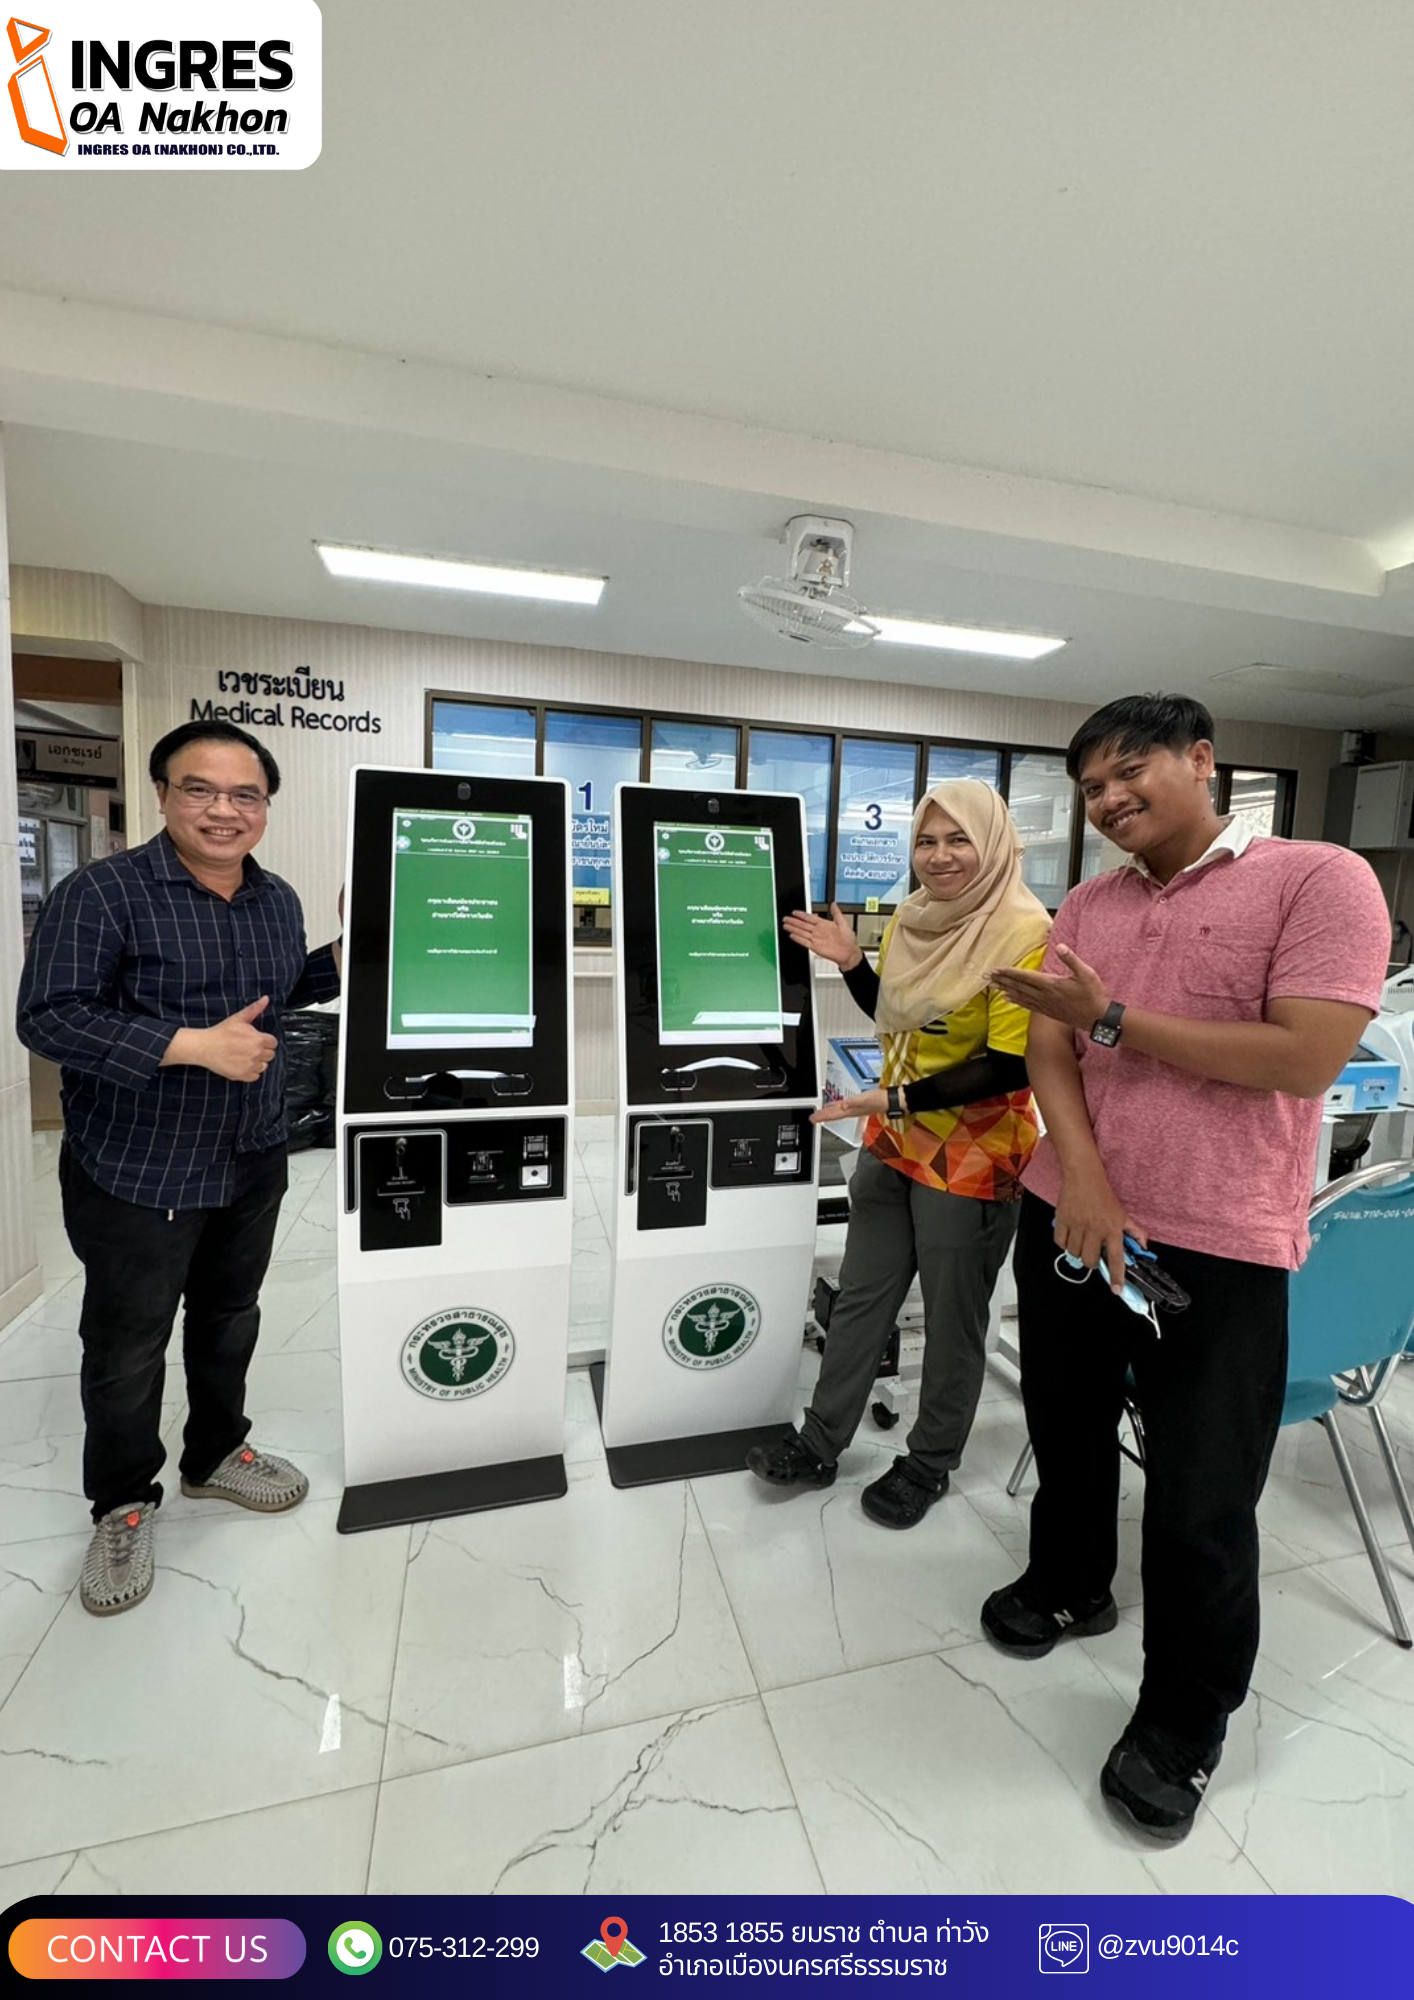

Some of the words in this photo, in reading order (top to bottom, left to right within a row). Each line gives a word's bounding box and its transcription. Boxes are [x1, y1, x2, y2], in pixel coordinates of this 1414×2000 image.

[217, 665, 345, 702] เวชระเบียน
[189, 698, 285, 727] Medical
[290, 706, 382, 735] Records
[578, 781, 592, 811] 1
[864, 803, 882, 831] 3
[668, 1338, 692, 1364] MINISTRY
[705, 1353, 732, 1367] PUBLIC
[732, 1330, 754, 1355] HEALTH
[408, 1367, 438, 1395] MINISTRY
[454, 1382, 485, 1397] PUBLIC
[485, 1356, 509, 1384] HEALTH
